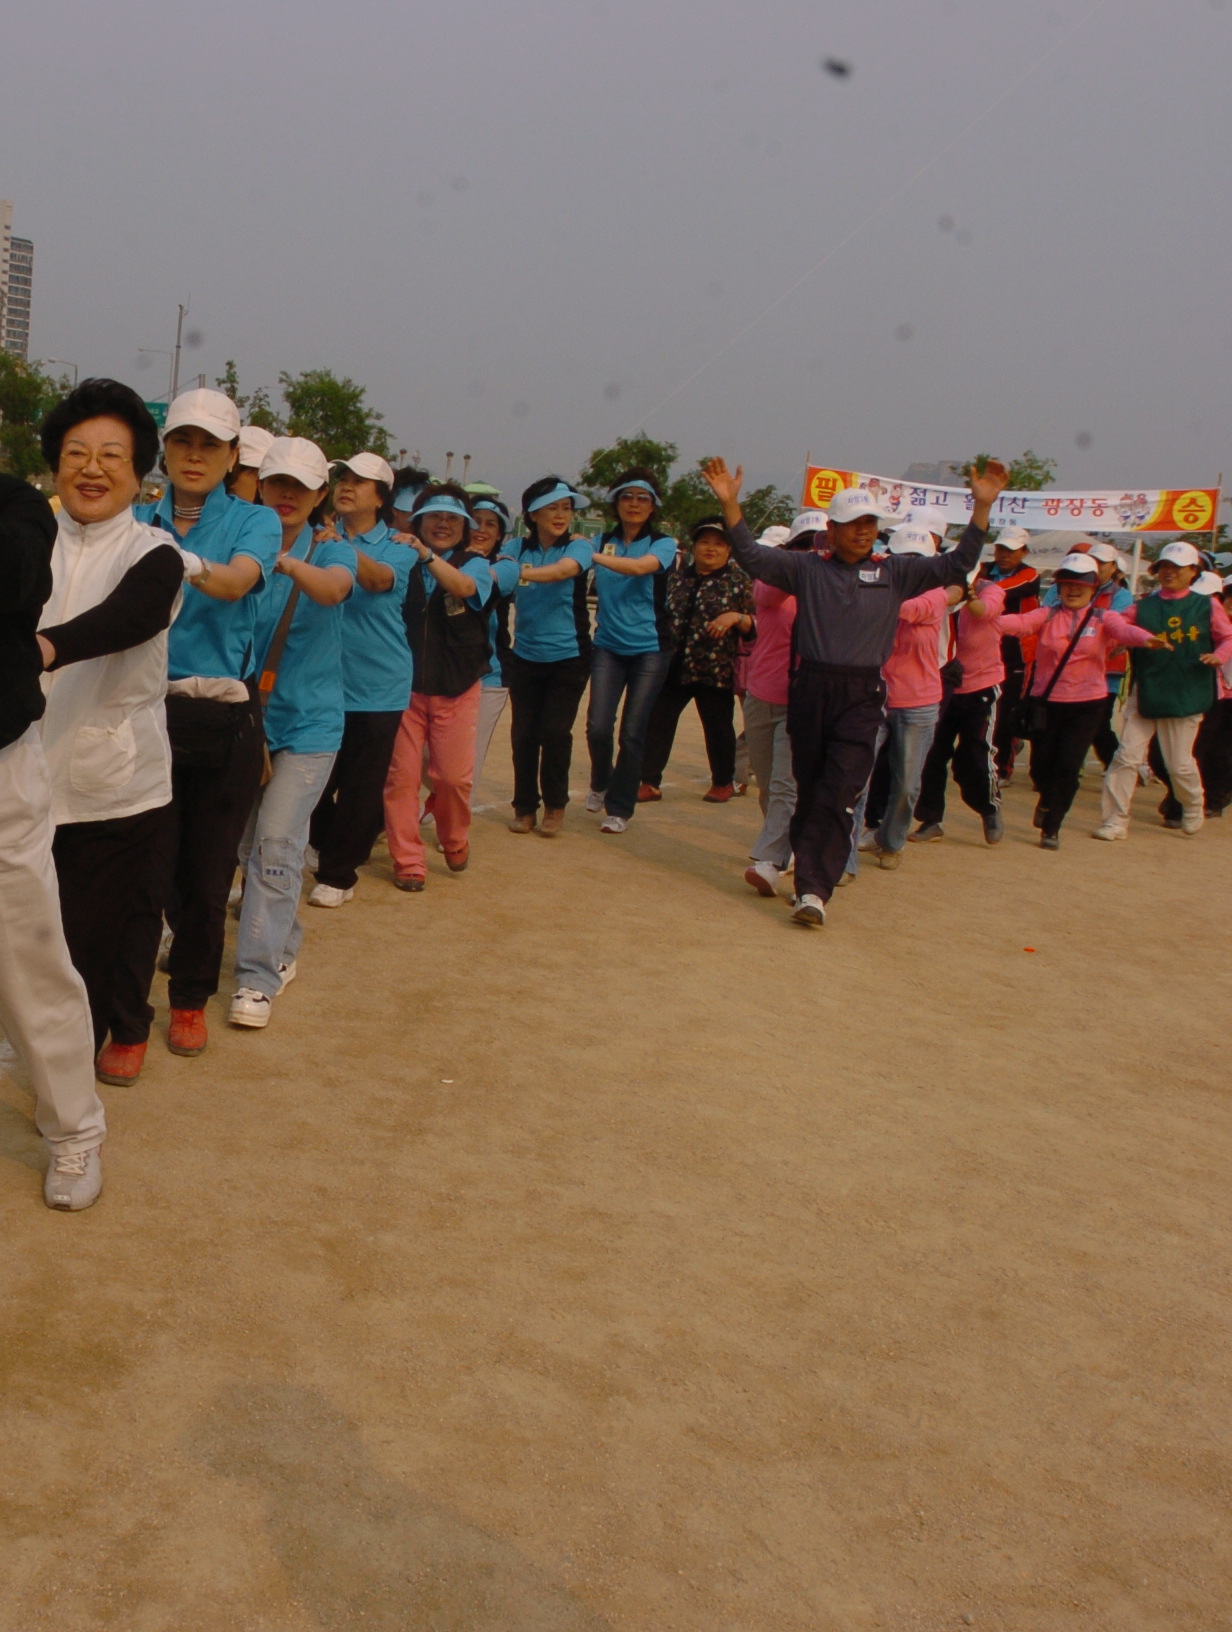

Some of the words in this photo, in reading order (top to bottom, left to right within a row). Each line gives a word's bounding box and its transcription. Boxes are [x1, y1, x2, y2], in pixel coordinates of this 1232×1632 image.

[815, 476, 838, 502] 필
[1042, 498, 1109, 517] 광장동
[1177, 497, 1206, 525] 승
